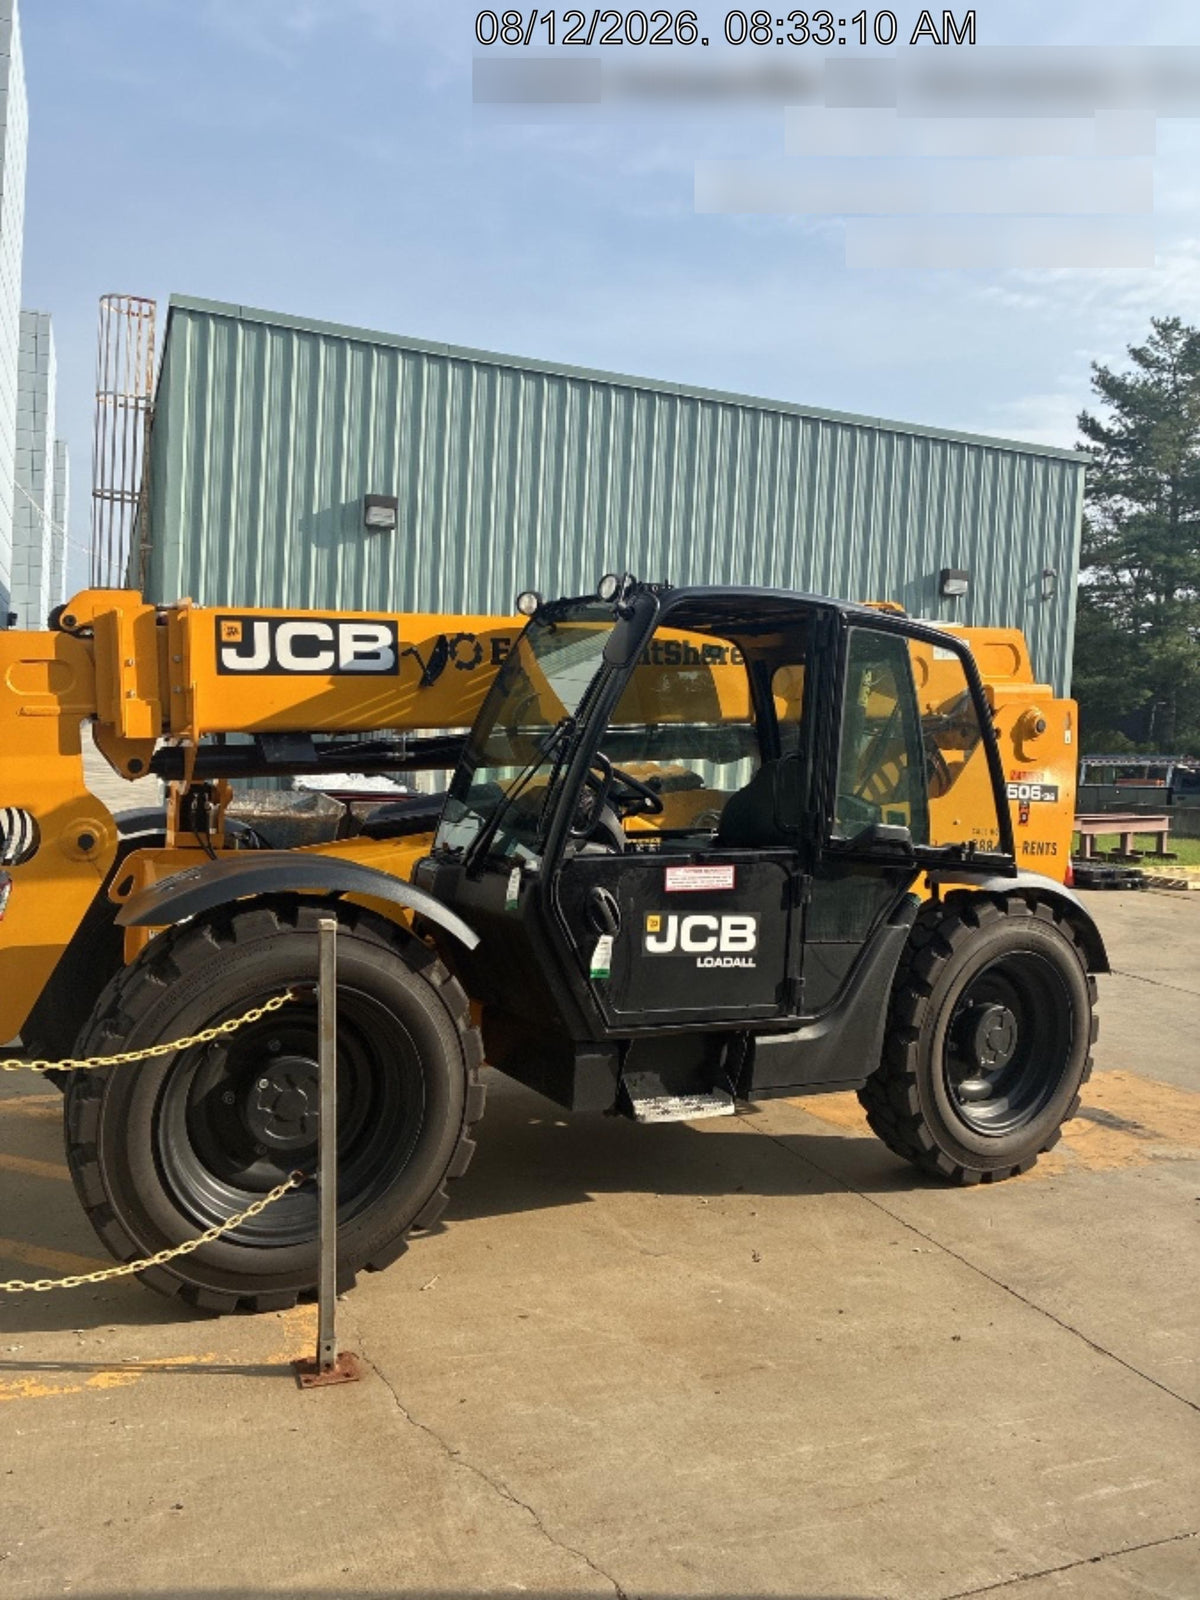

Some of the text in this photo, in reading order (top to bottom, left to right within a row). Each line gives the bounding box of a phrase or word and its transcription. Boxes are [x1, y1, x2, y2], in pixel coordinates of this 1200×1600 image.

[221, 621, 395, 671] JCB
[645, 914, 757, 954] JCB
[696, 956, 757, 968] LOADALL
